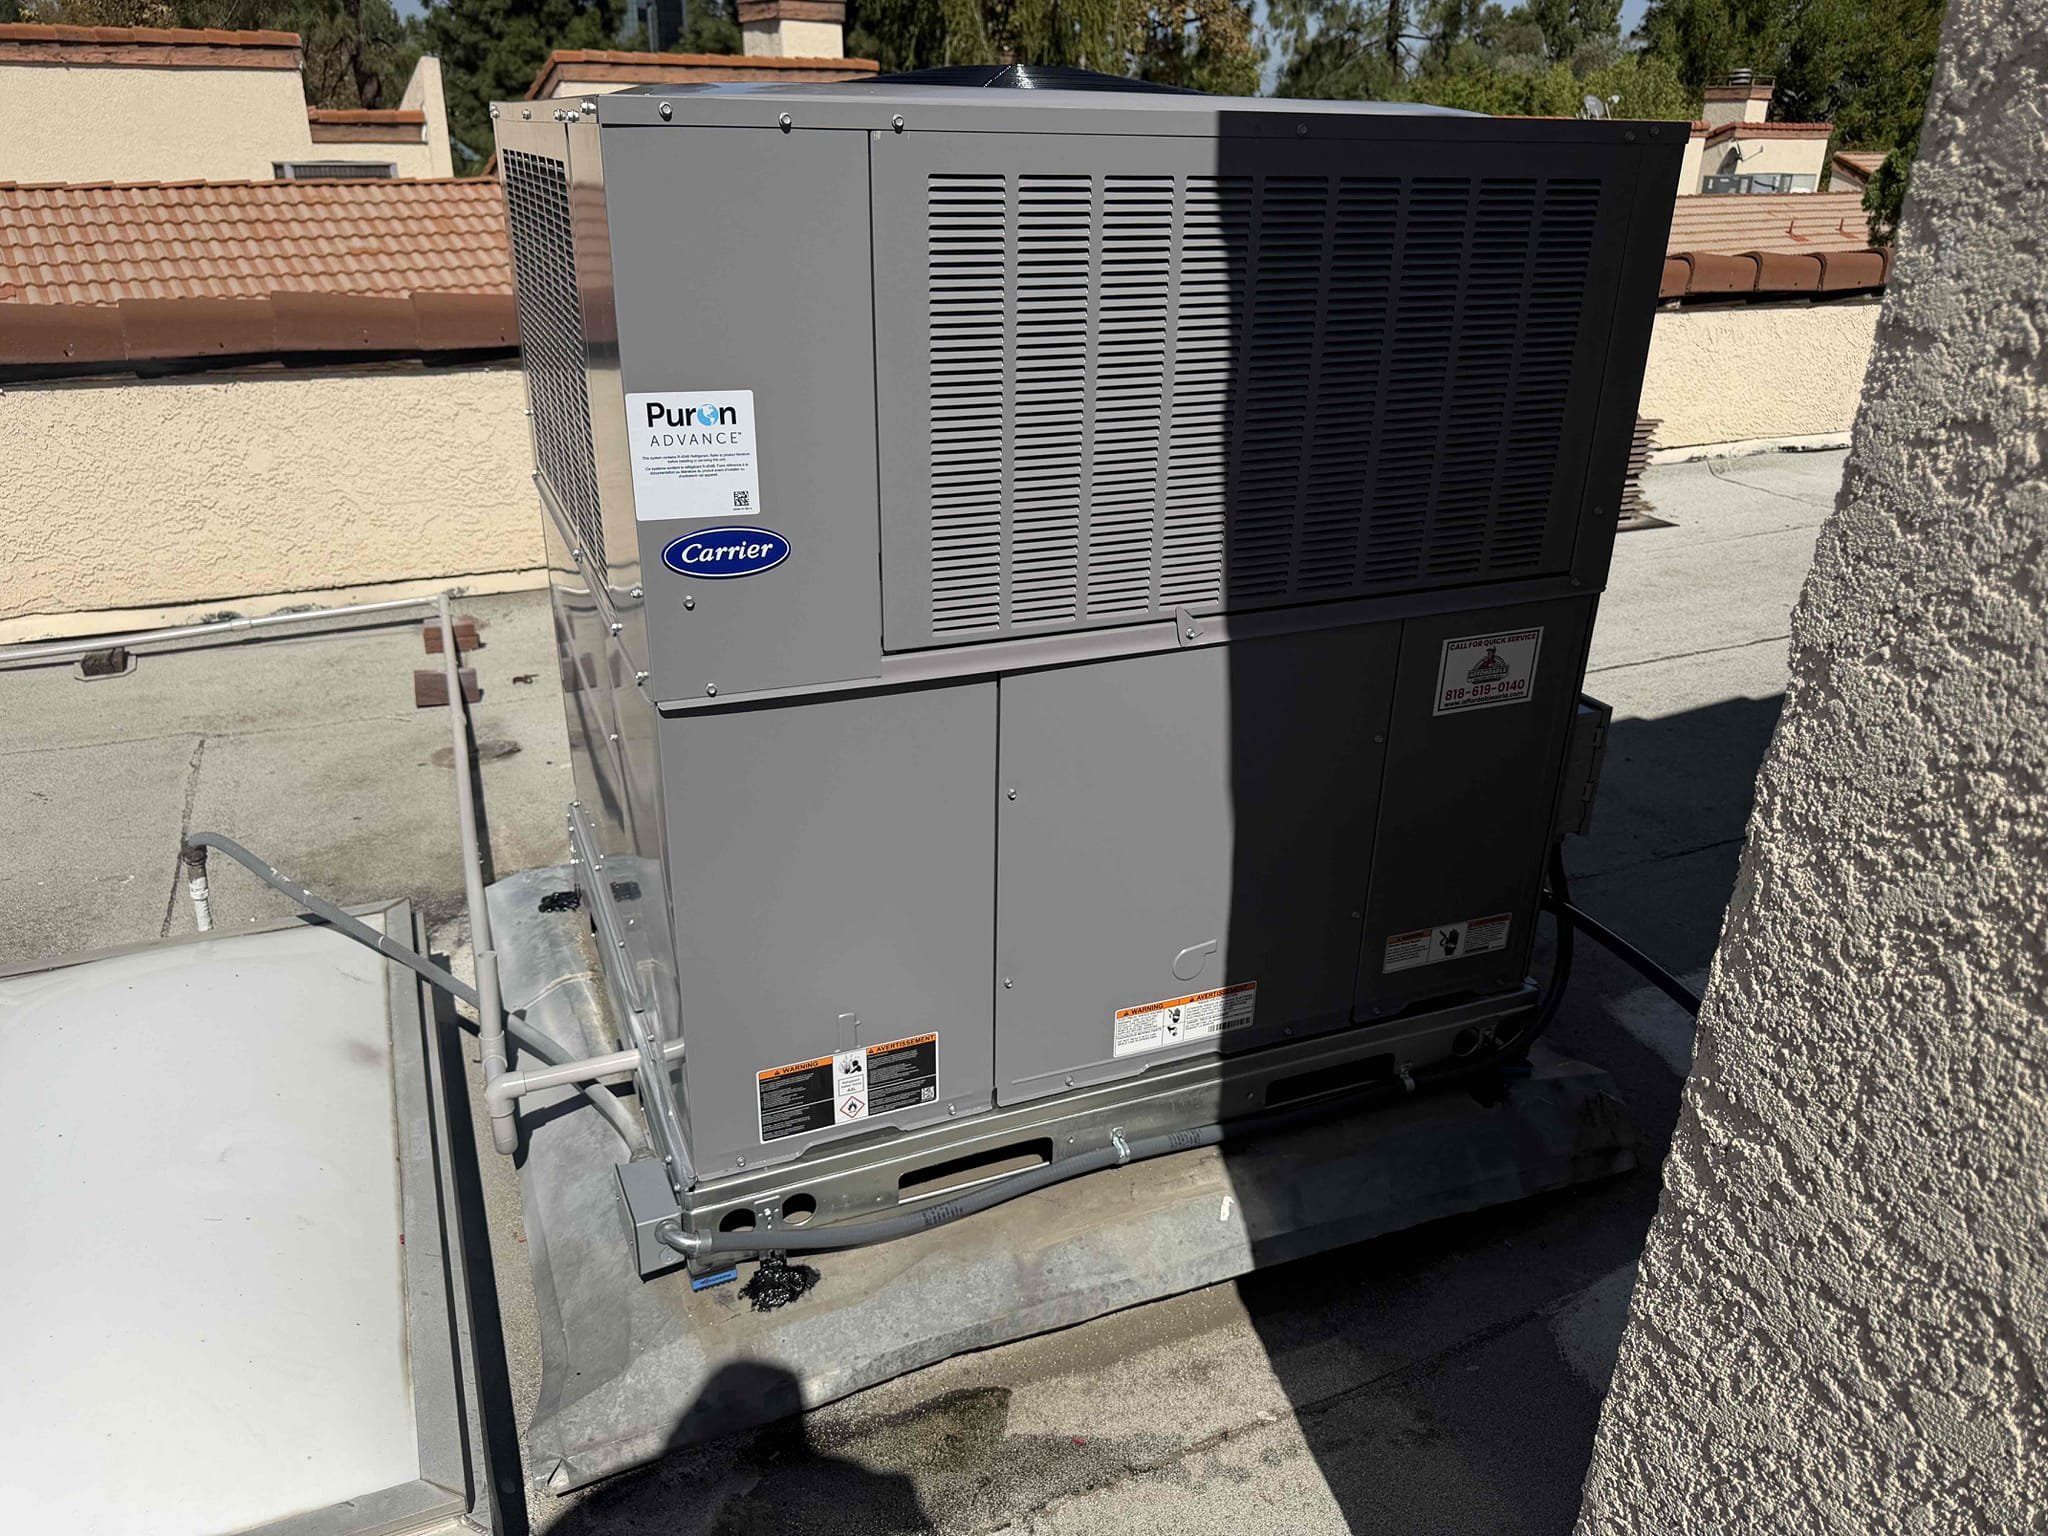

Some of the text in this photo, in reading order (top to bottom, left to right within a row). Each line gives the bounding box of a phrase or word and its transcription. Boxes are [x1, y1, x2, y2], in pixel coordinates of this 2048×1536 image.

[646, 402, 737, 428] Puron
[681, 541, 774, 564] Carrier
[1449, 633, 1536, 651] CALL FOR QUICK SERVICE
[1445, 679, 1525, 701] 818-619-0140
[1131, 1003, 1163, 1015] WARNING
[876, 1034, 935, 1052] AVERTISSEMENT
[782, 1061, 819, 1074] WARNING
